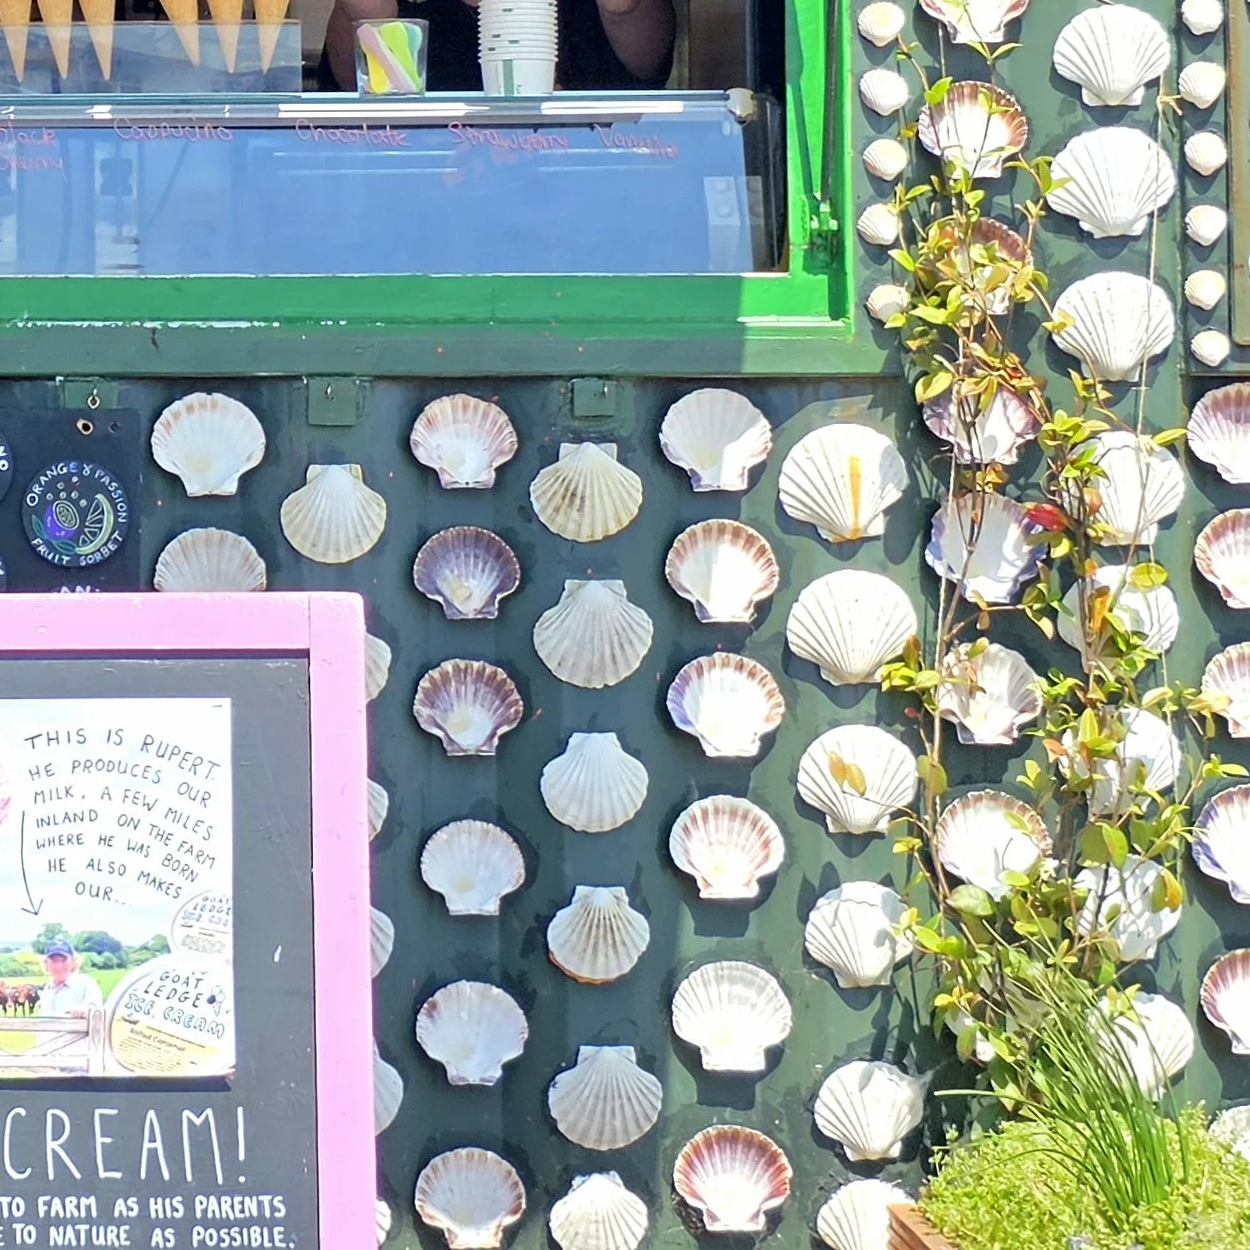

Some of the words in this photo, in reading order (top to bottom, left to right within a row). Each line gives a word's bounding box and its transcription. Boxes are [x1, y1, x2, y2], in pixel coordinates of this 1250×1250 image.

[295, 118, 411, 146] Chocolate
[26, 461, 78, 507] ORANGE
[94, 469, 128, 523] PASSION
[31, 537, 71, 566] FRUIT
[79, 530, 123, 566] SORBET
[24, 728, 87, 750] THIS
[106, 728, 124, 747] IS
[29, 762, 55, 781] HE
[71, 758, 162, 784] PRODUCES
[177, 781, 212, 809] OUR
[100, 786, 112, 801] A
[122, 788, 159, 812] FEW
[164, 806, 213, 841] MILES
[36, 809, 99, 829] INLAND
[117, 813, 141, 831] ON
[149, 823, 174, 847] THE
[177, 840, 216, 869] FARM
[35, 833, 85, 850] WHERE
[98, 834, 115, 848] HE
[127, 838, 151, 859] WAS
[161, 853, 199, 883] BORN
[48, 857, 68, 873] HE
[85, 857, 127, 877] ALSO
[137, 870, 183, 899] MAKES
[144, 981, 203, 1008] LEDGE
[159, 971, 205, 989] GOAT
[163, 1006, 225, 1039] CREAM
[2, 1106, 248, 1185] CREAM!
[37, 1195, 97, 1218] FARM
[113, 1197, 139, 1218] AS
[149, 1196, 185, 1218] HIS
[194, 1195, 286, 1220] PARENTS
[12, 1222, 37, 1245] TO
[49, 1224, 131, 1246] NATURE
[150, 1227, 175, 1248] AS
[192, 1225, 295, 1249] POSSIBLE.
